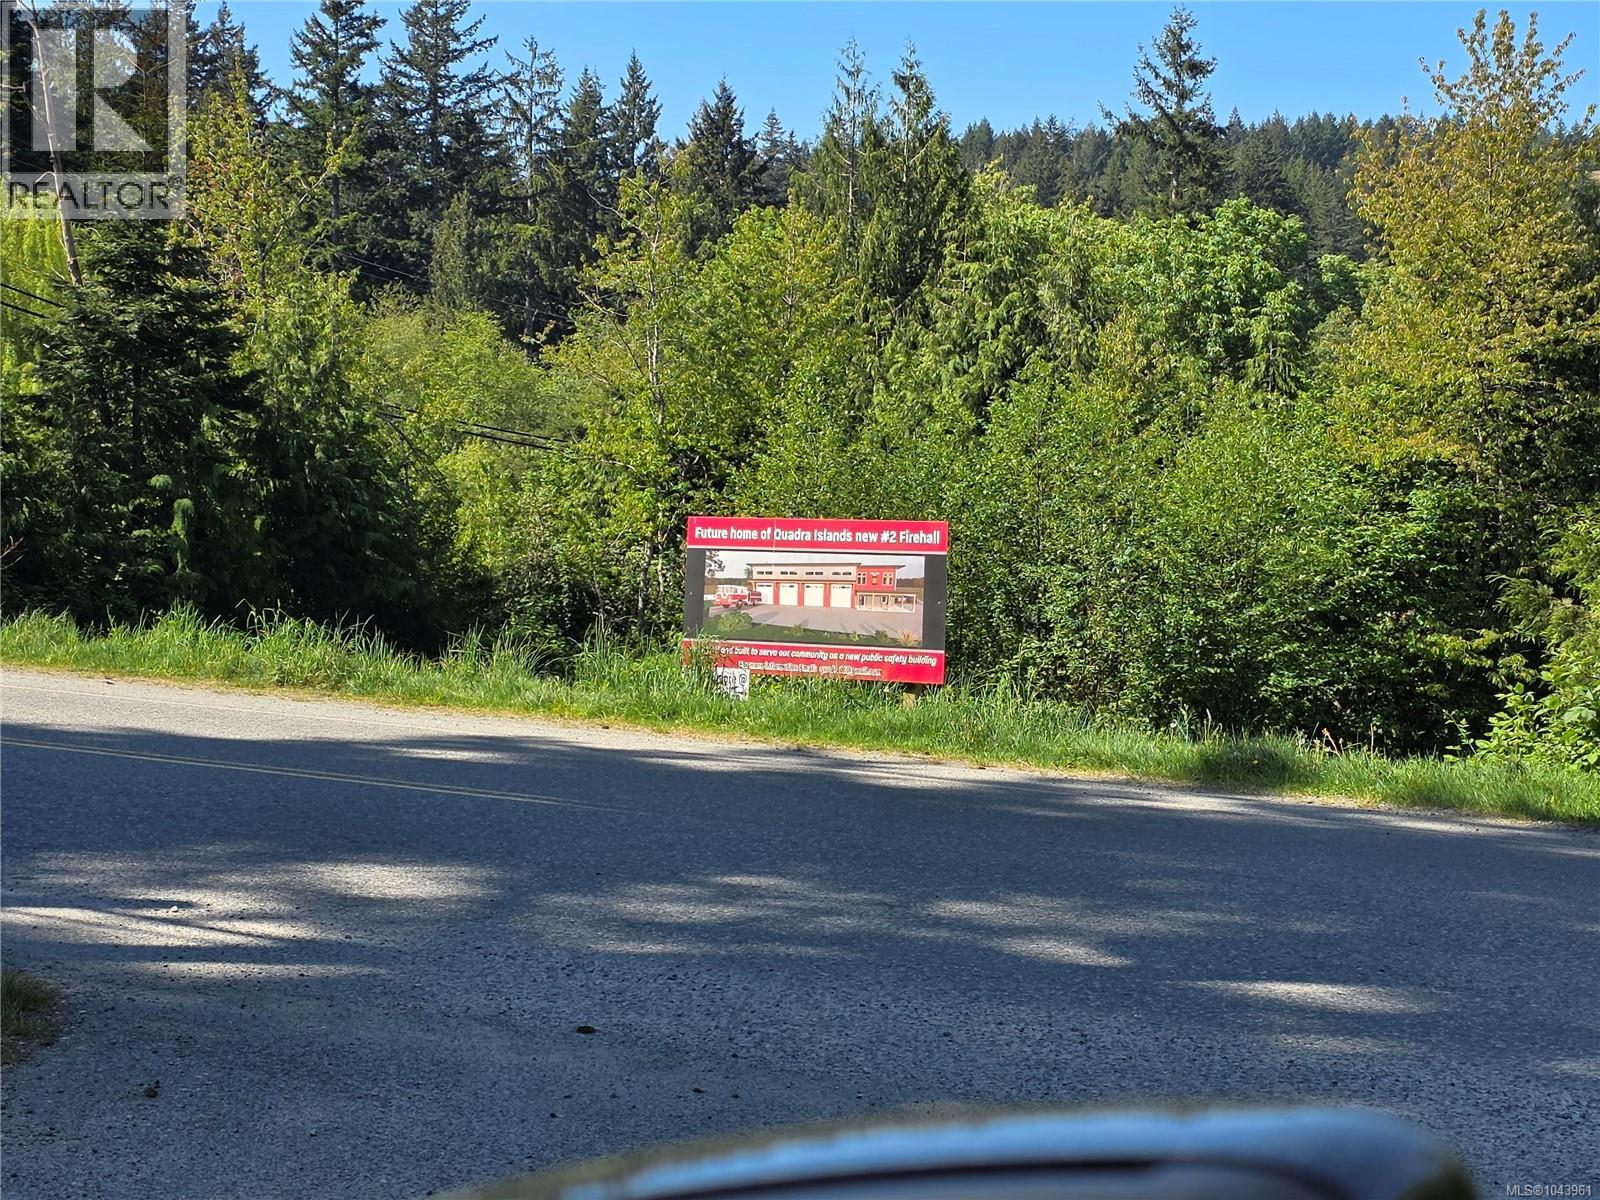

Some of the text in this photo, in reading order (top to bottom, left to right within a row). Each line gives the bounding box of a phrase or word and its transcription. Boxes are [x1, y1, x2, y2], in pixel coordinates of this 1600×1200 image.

[695, 526, 940, 544] Future home of Quadra Islands new #2 Firehall
[734, 646, 750, 655] built
[751, 647, 758, 655] to
[759, 648, 777, 656] serve
[778, 649, 790, 657] our
[791, 649, 829, 661] community
[845, 653, 860, 661] new
[861, 653, 882, 663] public
[884, 655, 907, 665] safety
[908, 656, 937, 667] building
